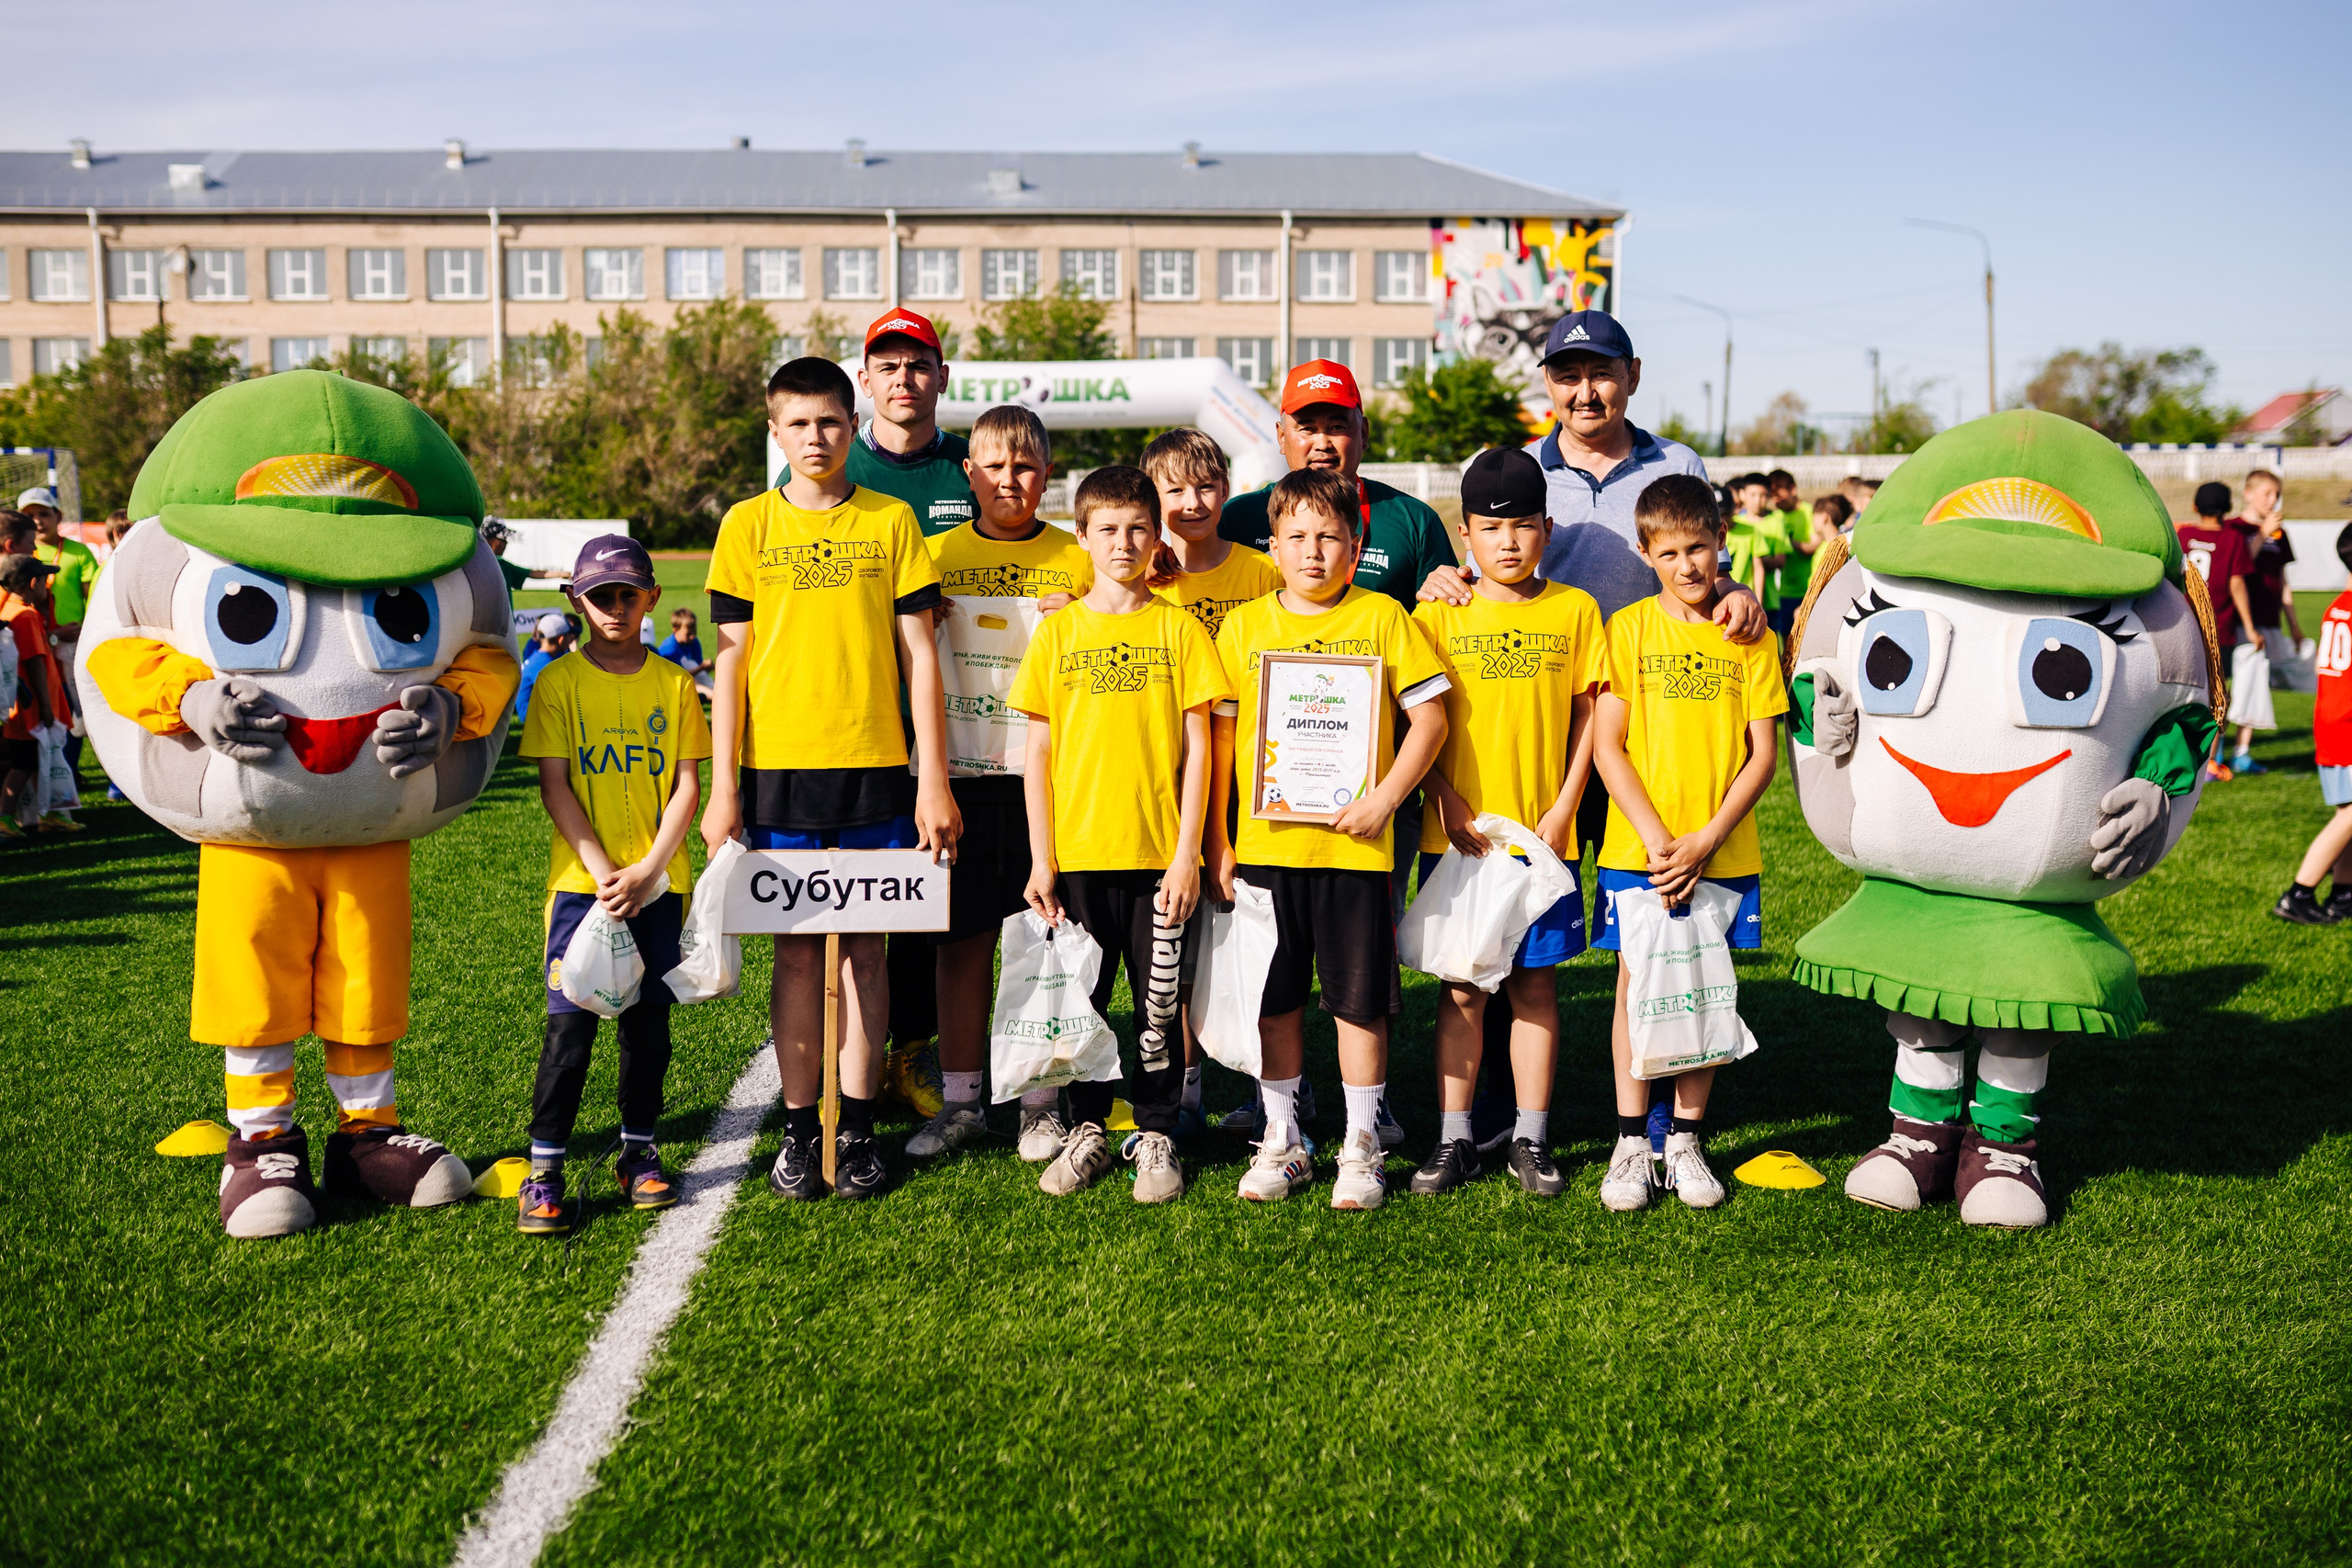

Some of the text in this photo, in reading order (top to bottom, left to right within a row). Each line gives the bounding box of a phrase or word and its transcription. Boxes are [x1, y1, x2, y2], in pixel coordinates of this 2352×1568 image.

[1564, 334, 1590, 344] adidas
[1309, 381, 1330, 390] 2025
[928, 505, 973, 519] КОМАНДА
[757, 538, 887, 568] МЕТРОШКА
[792, 561, 854, 591] 2025
[942, 563, 1073, 589] МЕТРОШКА
[1449, 628, 1569, 656] МЕТРОШКА
[2318, 621, 2352, 671] 10
[970, 661, 1011, 670] ПОБЕЖДАЙ!
[1059, 642, 1176, 673] МЕТРОШКА
[1481, 653, 1542, 679] 2025
[1091, 666, 1148, 694] 2025
[1664, 673, 1721, 701] 2025
[1304, 703, 1330, 714] 2025
[1286, 718, 1349, 731] ДИПЛОМ
[1297, 731, 1338, 739] УЧАСТНИКА
[949, 759, 1008, 772] METROSHKA.RU
[750, 869, 924, 911] Субутак
[1004, 1012, 1103, 1041] МЕТРОШКА
